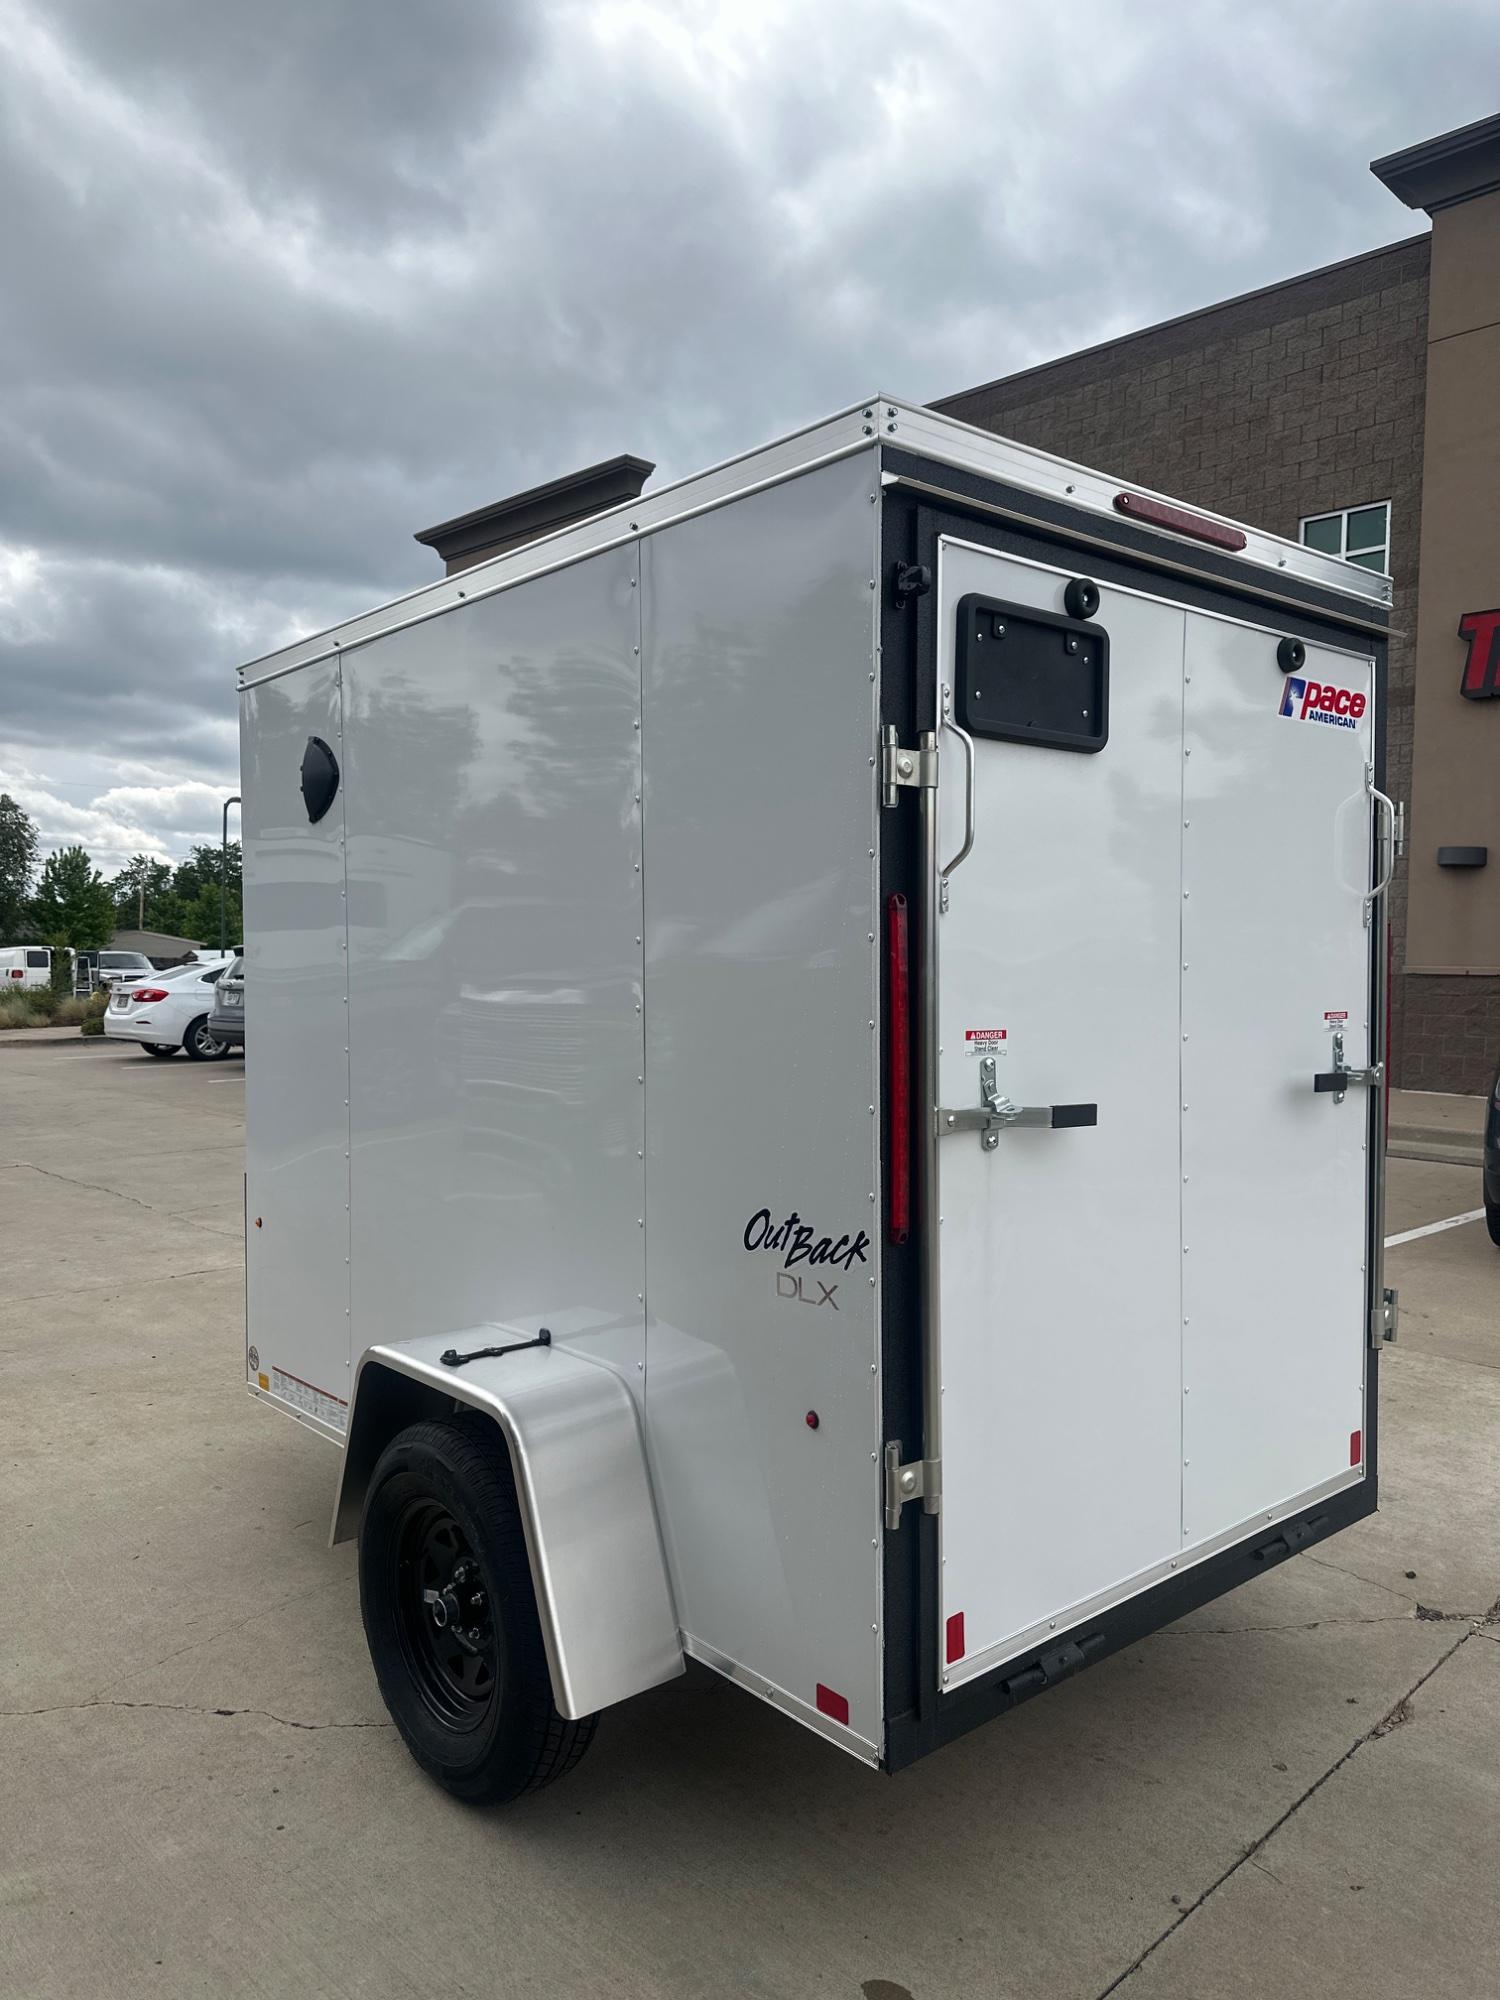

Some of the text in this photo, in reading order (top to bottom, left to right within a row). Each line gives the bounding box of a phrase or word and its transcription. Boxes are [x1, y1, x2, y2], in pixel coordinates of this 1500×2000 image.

[1458, 608, 1500, 700] T
[1300, 681, 1367, 720] pace
[1308, 709, 1357, 729] AMERICAN
[975, 1031, 1003, 1040] DANGER
[743, 1208, 870, 1271] OutBack
[776, 1271, 840, 1311] DLX
